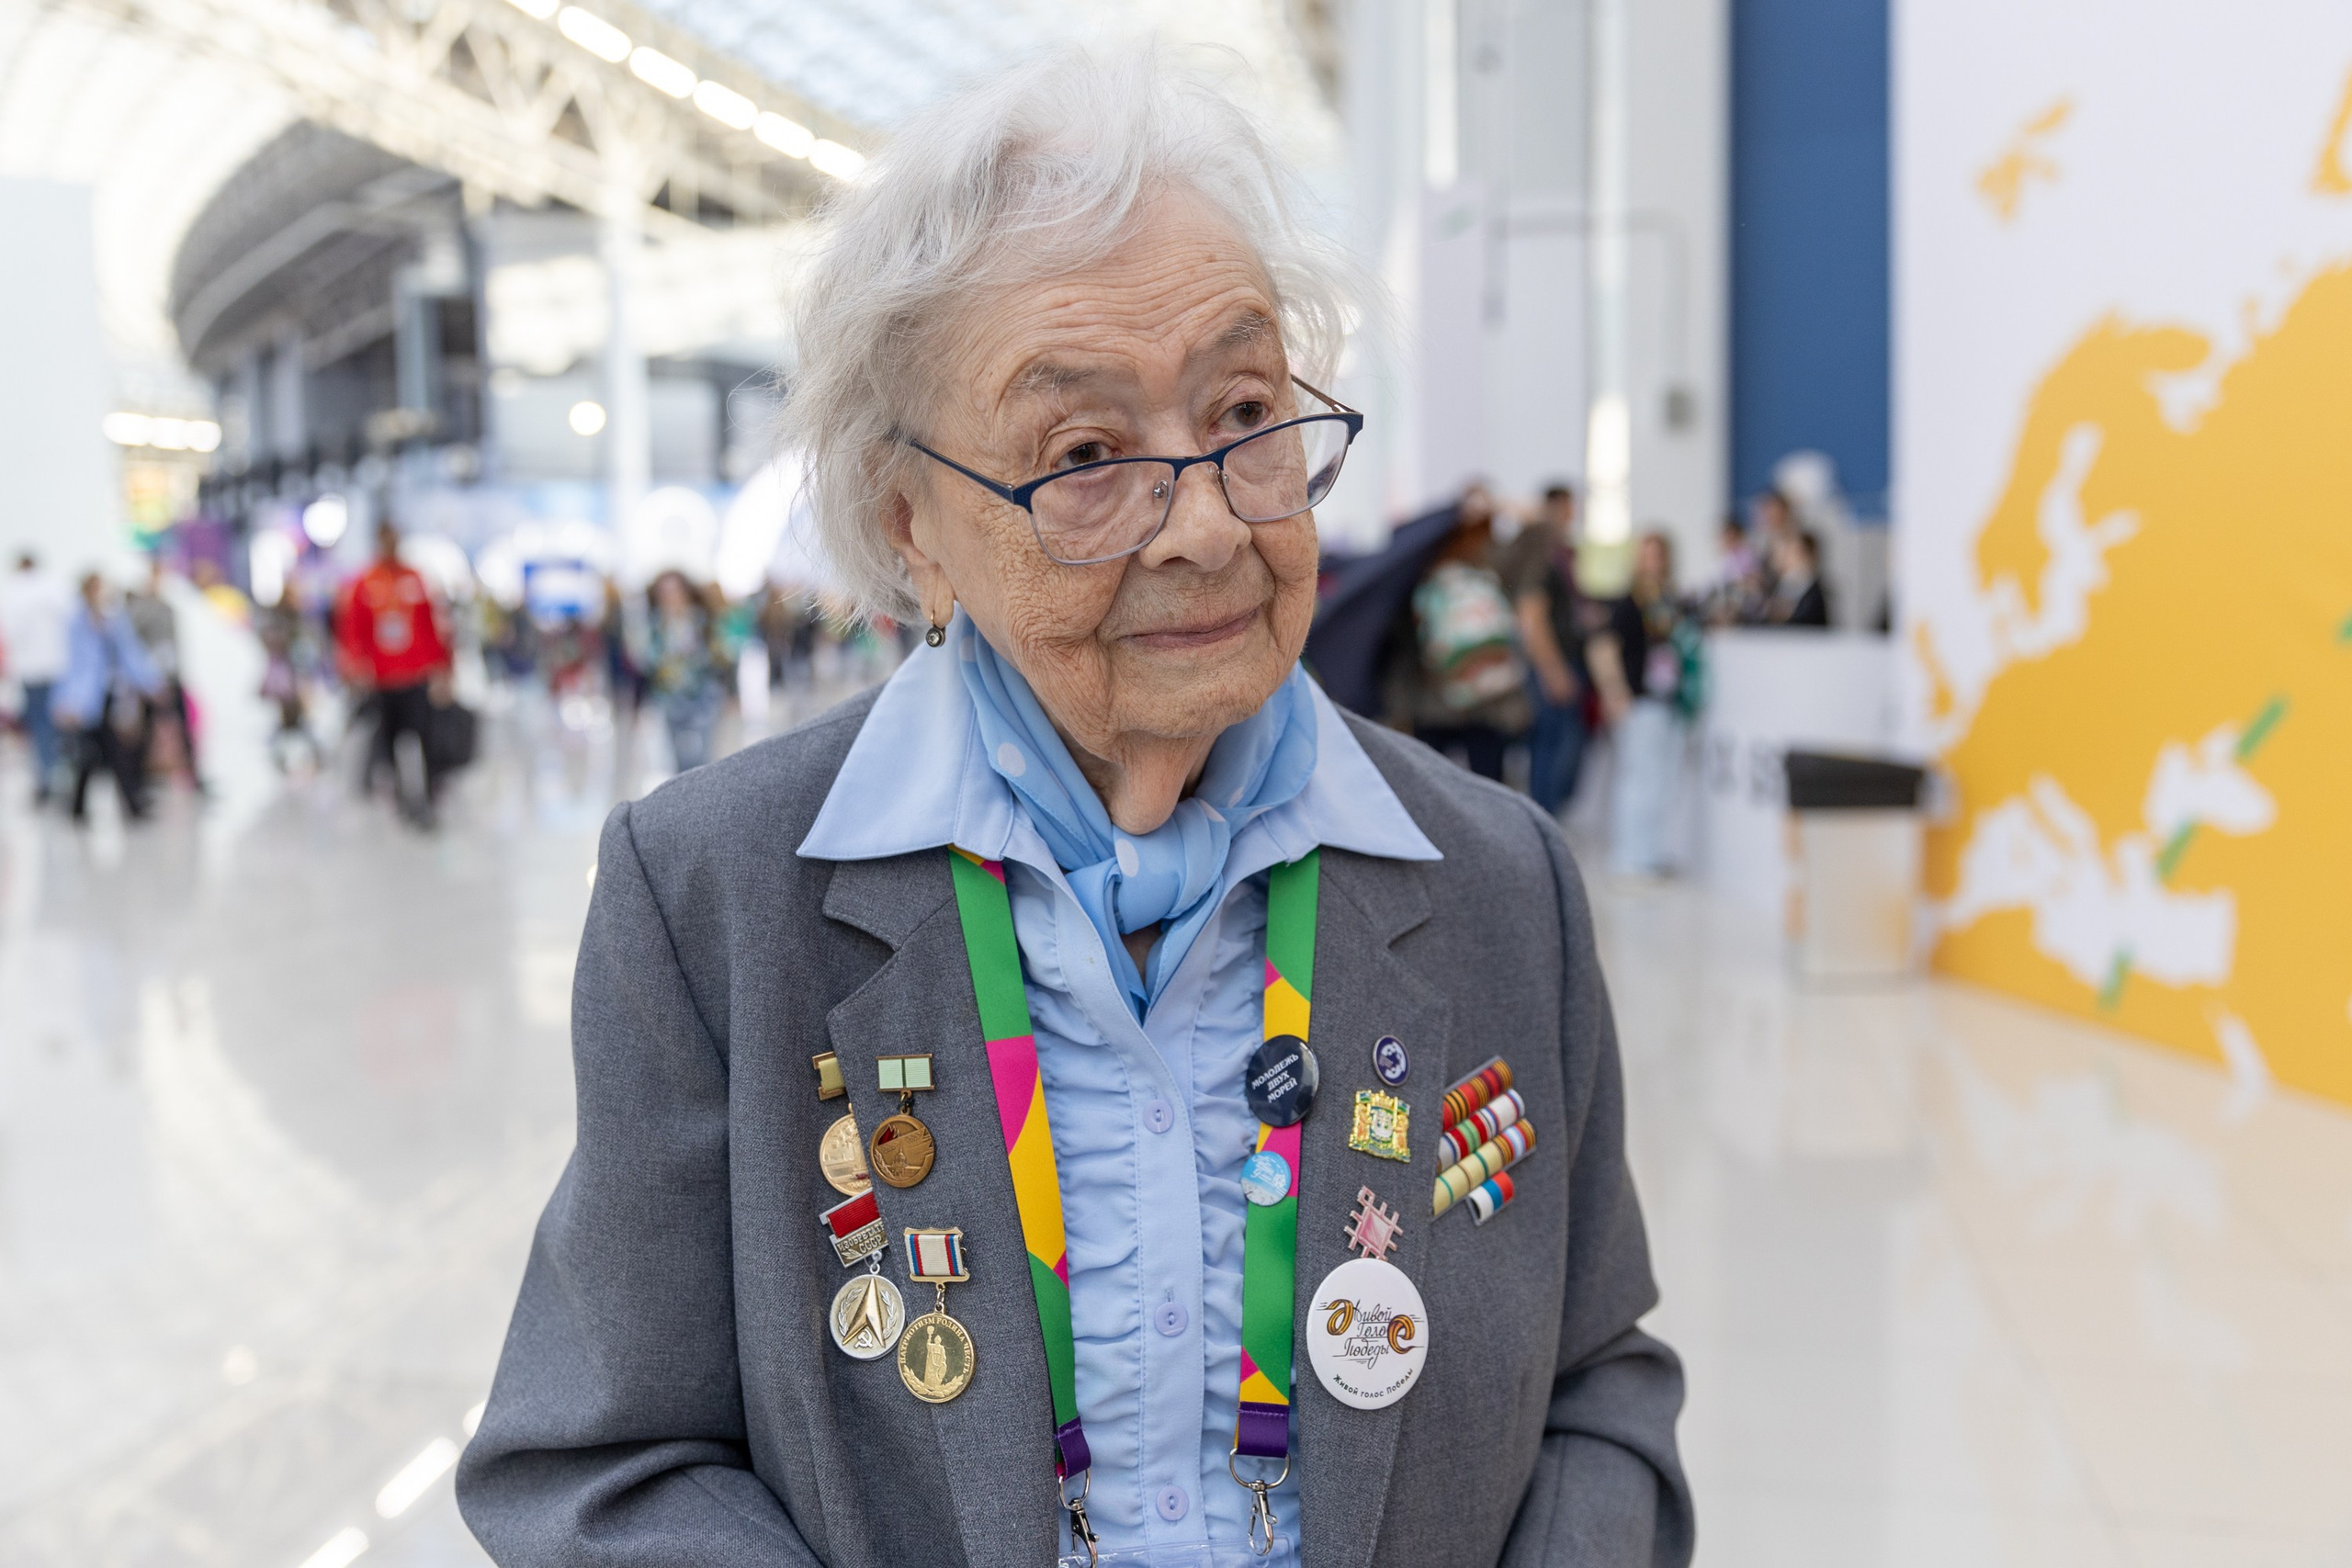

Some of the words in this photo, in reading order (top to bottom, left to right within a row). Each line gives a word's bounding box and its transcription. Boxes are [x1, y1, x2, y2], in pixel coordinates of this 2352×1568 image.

[1251, 1053, 1299, 1090] МОЛОДЕЖЬ
[1267, 1070, 1290, 1091] ДВУХ
[1267, 1077, 1298, 1103] МОРЕЙ
[859, 1235, 882, 1254] СССР
[899, 1317, 935, 1364] ПАТРИОТИЗМ
[937, 1317, 966, 1342] РОДИНА
[963, 1342, 972, 1374] ЧЕСТЬ
[1343, 1337, 1390, 1370] Победы
[1333, 1373, 1359, 1395] Живой
[1360, 1390, 1385, 1398] голос
[1386, 1368, 1413, 1394] Победы
